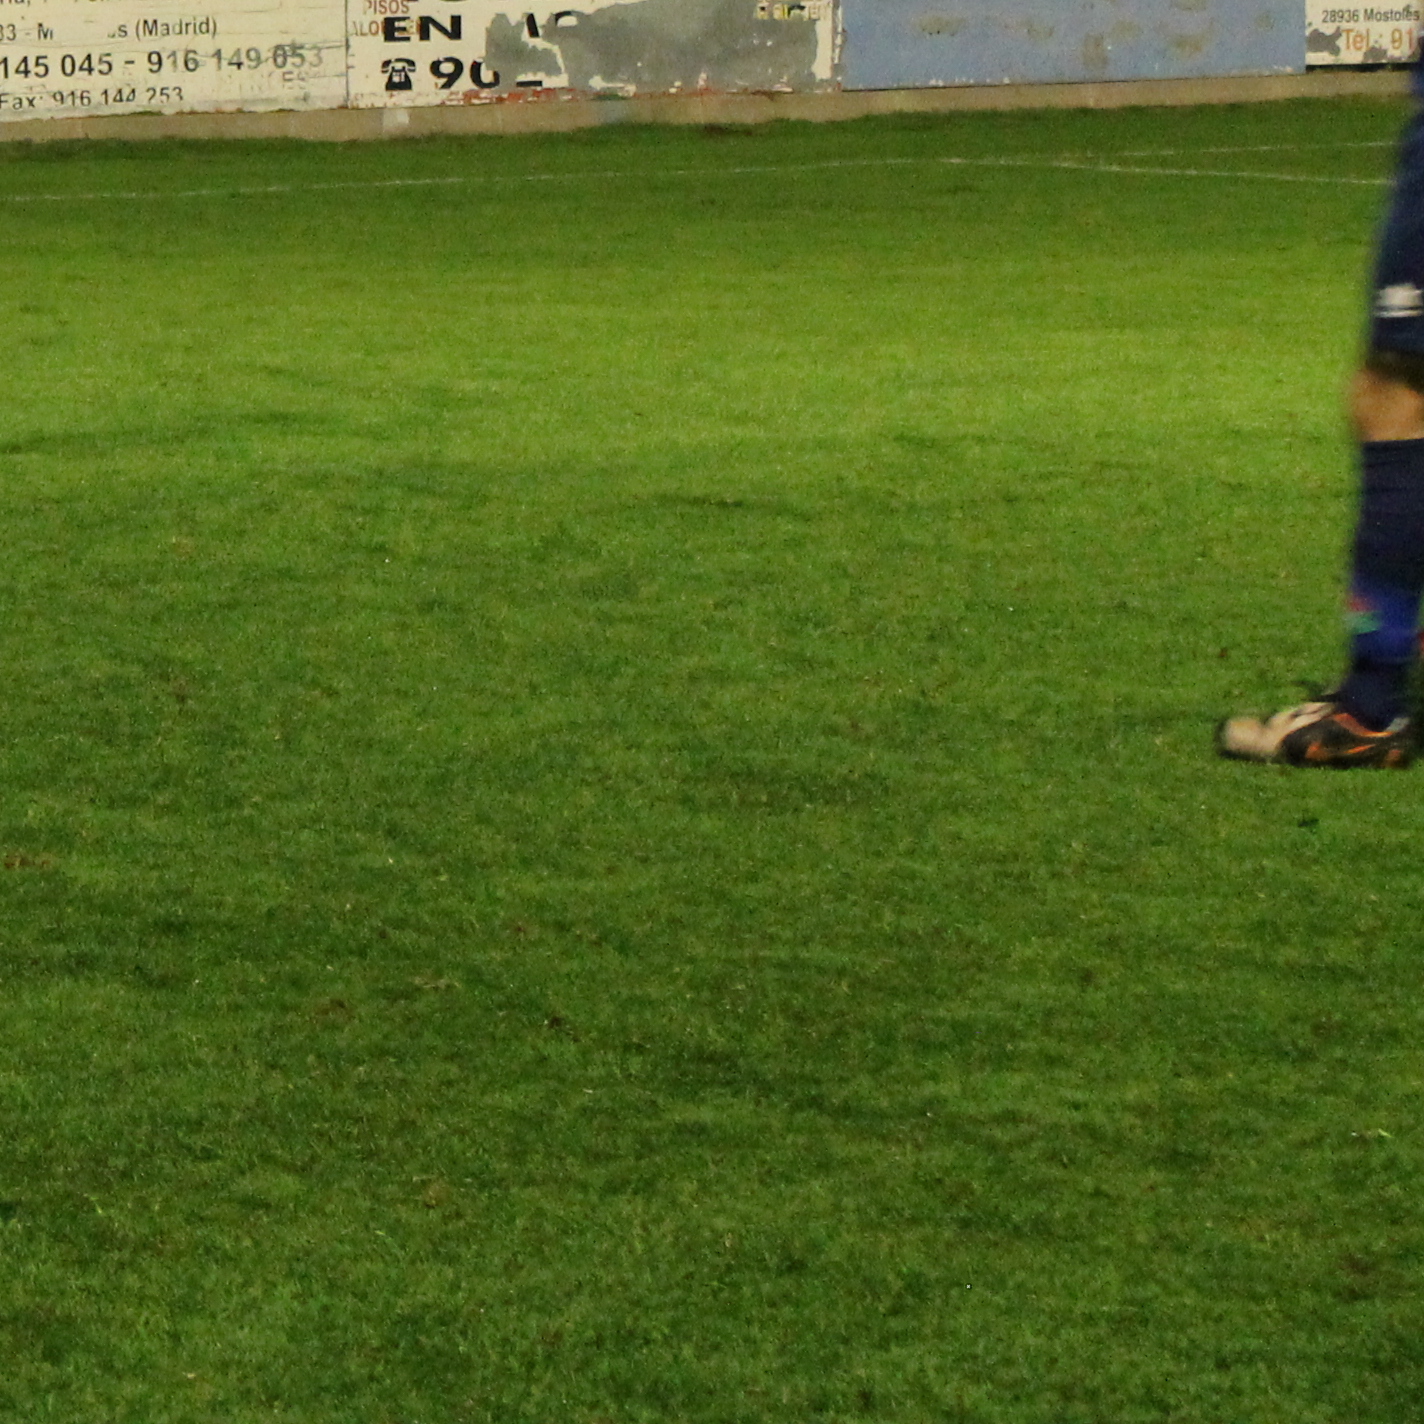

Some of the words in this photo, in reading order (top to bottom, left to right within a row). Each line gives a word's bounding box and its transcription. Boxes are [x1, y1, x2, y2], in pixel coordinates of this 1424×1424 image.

[384, 15, 462, 43] EN
[1321, 8, 1359, 23] 28936
[134, 16, 218, 43] (Madrid)
[60, 52, 113, 77] 045
[146, 49, 201, 74] 916
[211, 46, 262, 71] 149
[52, 90, 92, 108] 916
